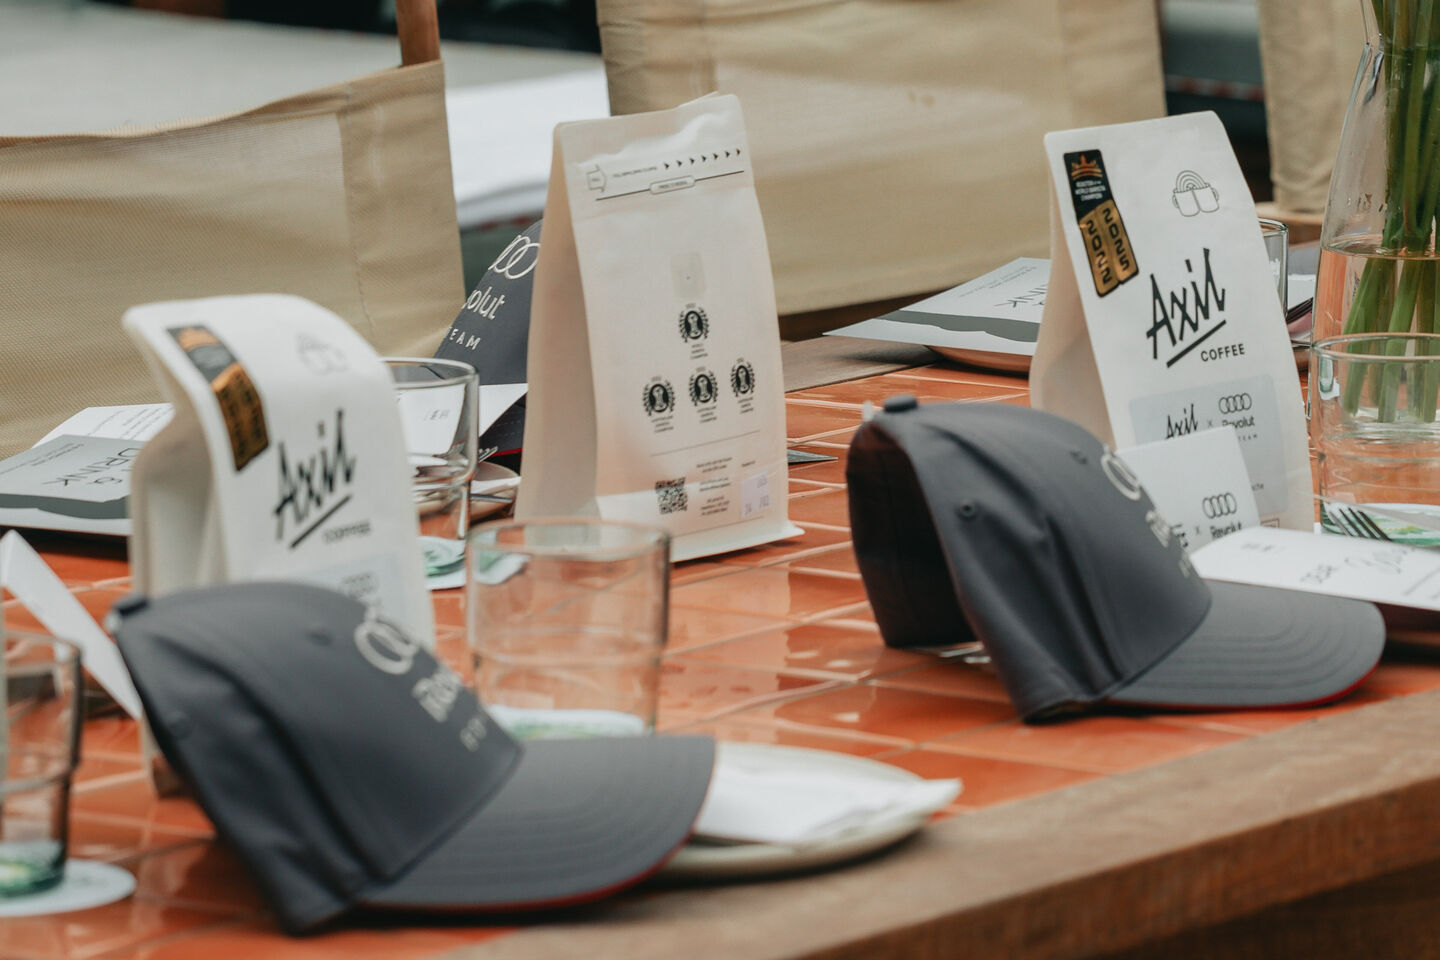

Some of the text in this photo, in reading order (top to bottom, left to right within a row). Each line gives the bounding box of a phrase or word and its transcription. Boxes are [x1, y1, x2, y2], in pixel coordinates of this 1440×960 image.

[1086, 220, 1112, 284] 2022
[1102, 207, 1130, 271] 2025
[1146, 247, 1226, 360] Axil
[1200, 343, 1245, 362] COFFEE
[273, 409, 356, 541] Axil
